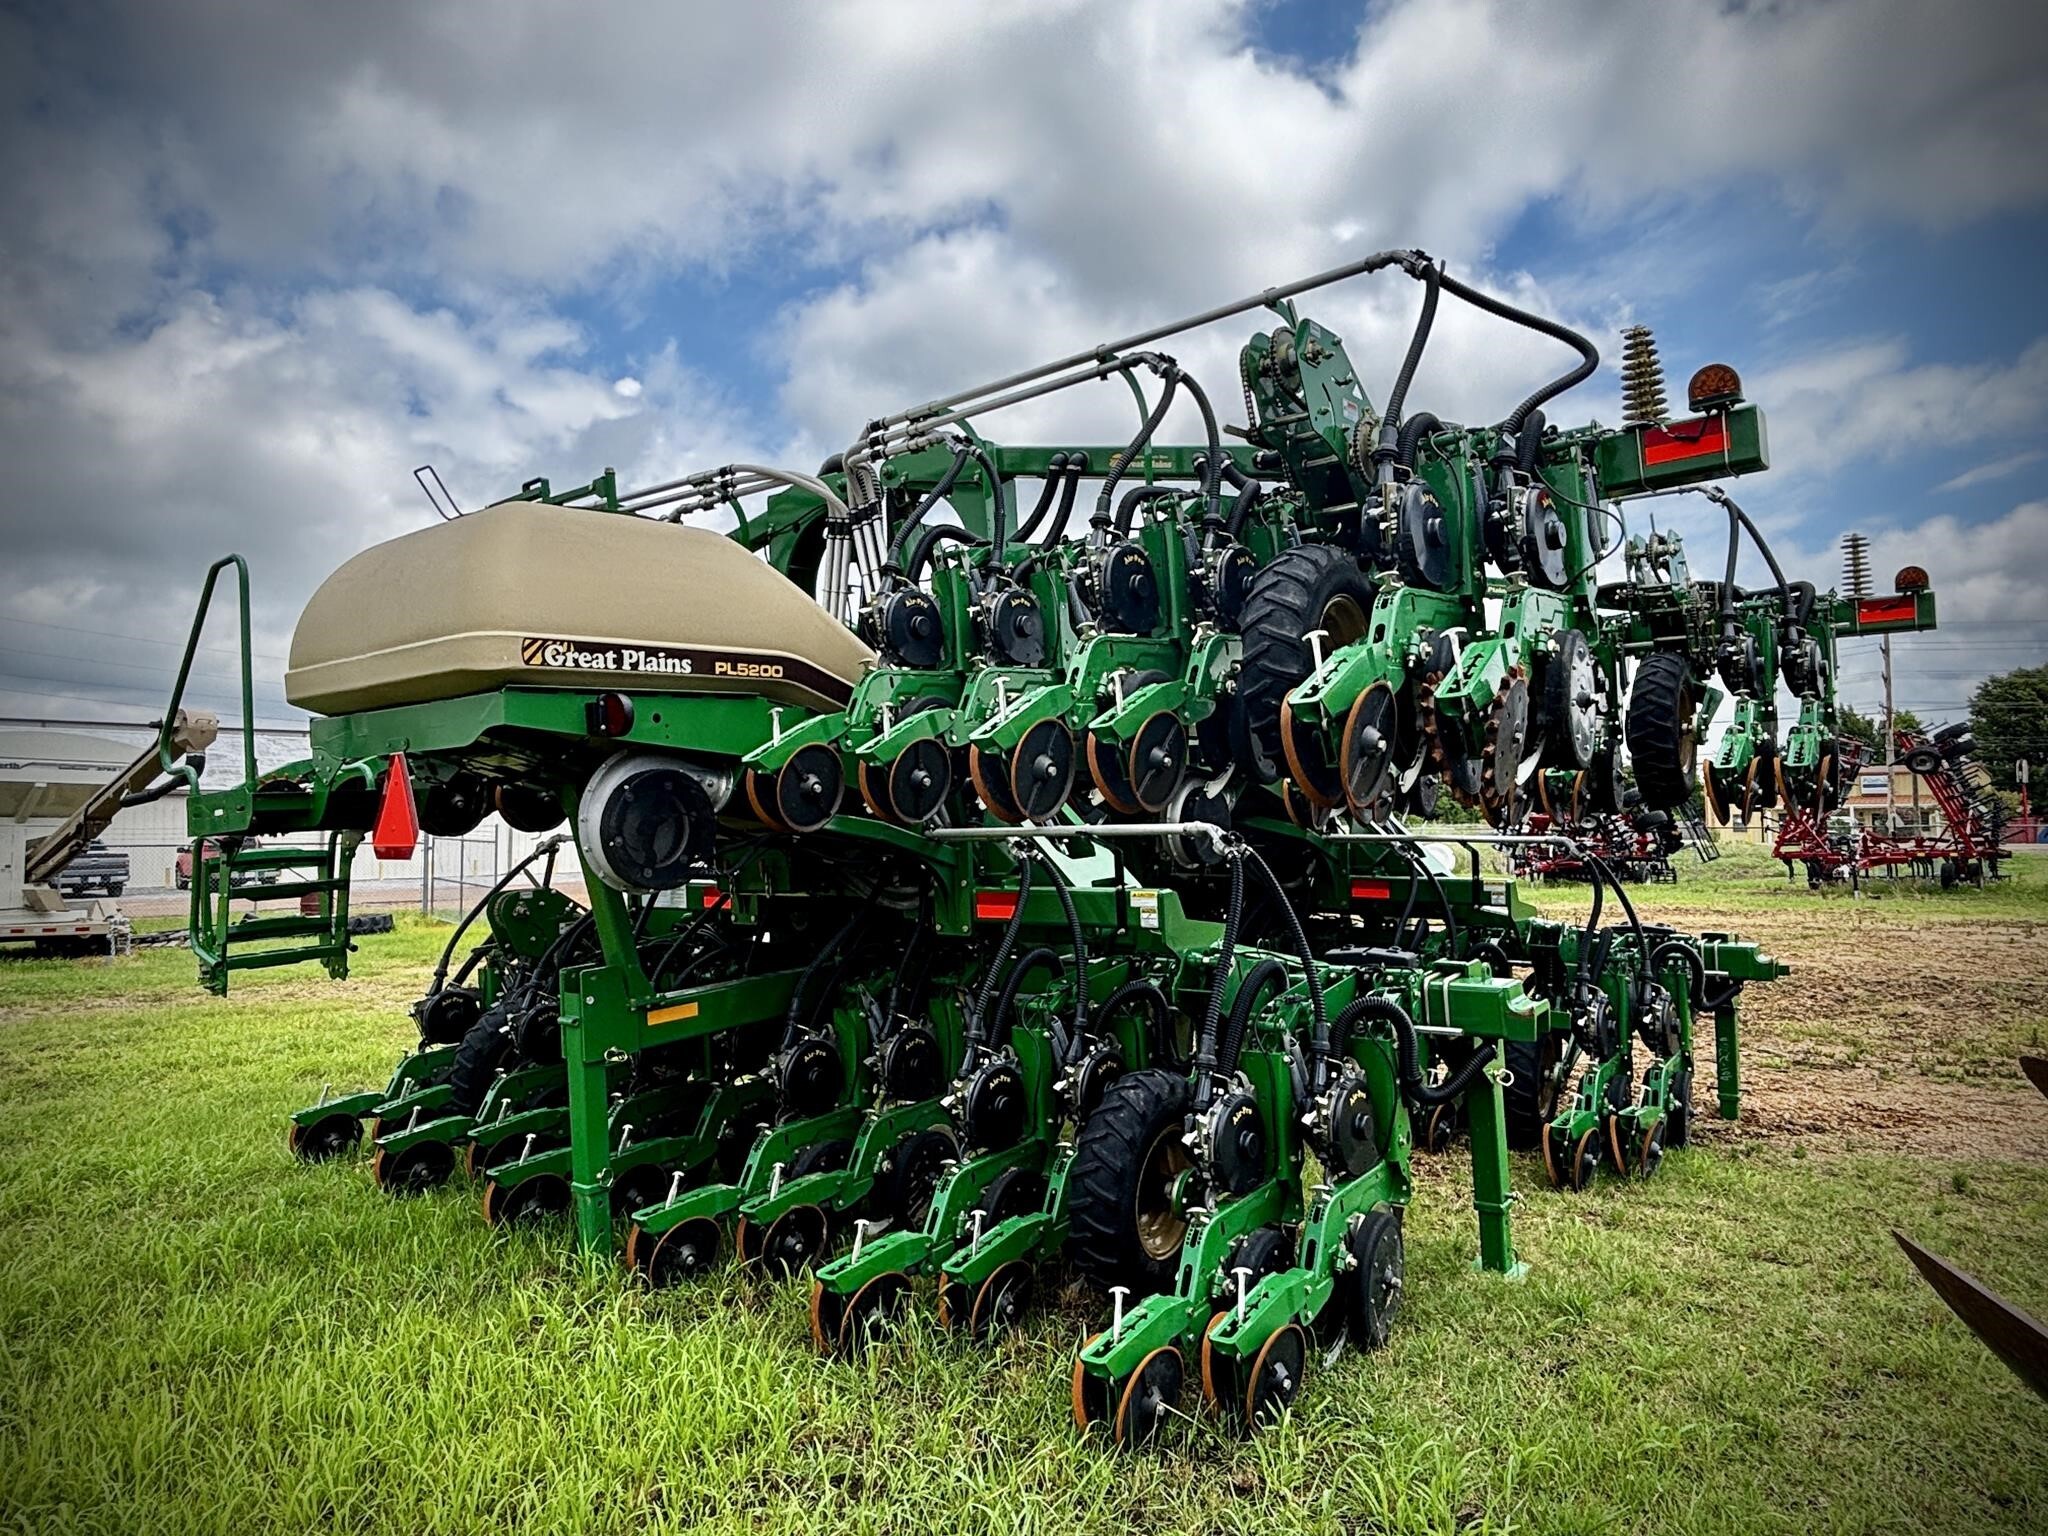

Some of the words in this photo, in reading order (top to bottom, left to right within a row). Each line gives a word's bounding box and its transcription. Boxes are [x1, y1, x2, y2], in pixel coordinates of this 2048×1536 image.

[544, 643, 617, 670] Great
[621, 649, 692, 674] Plains
[714, 661, 784, 678] PL5200
